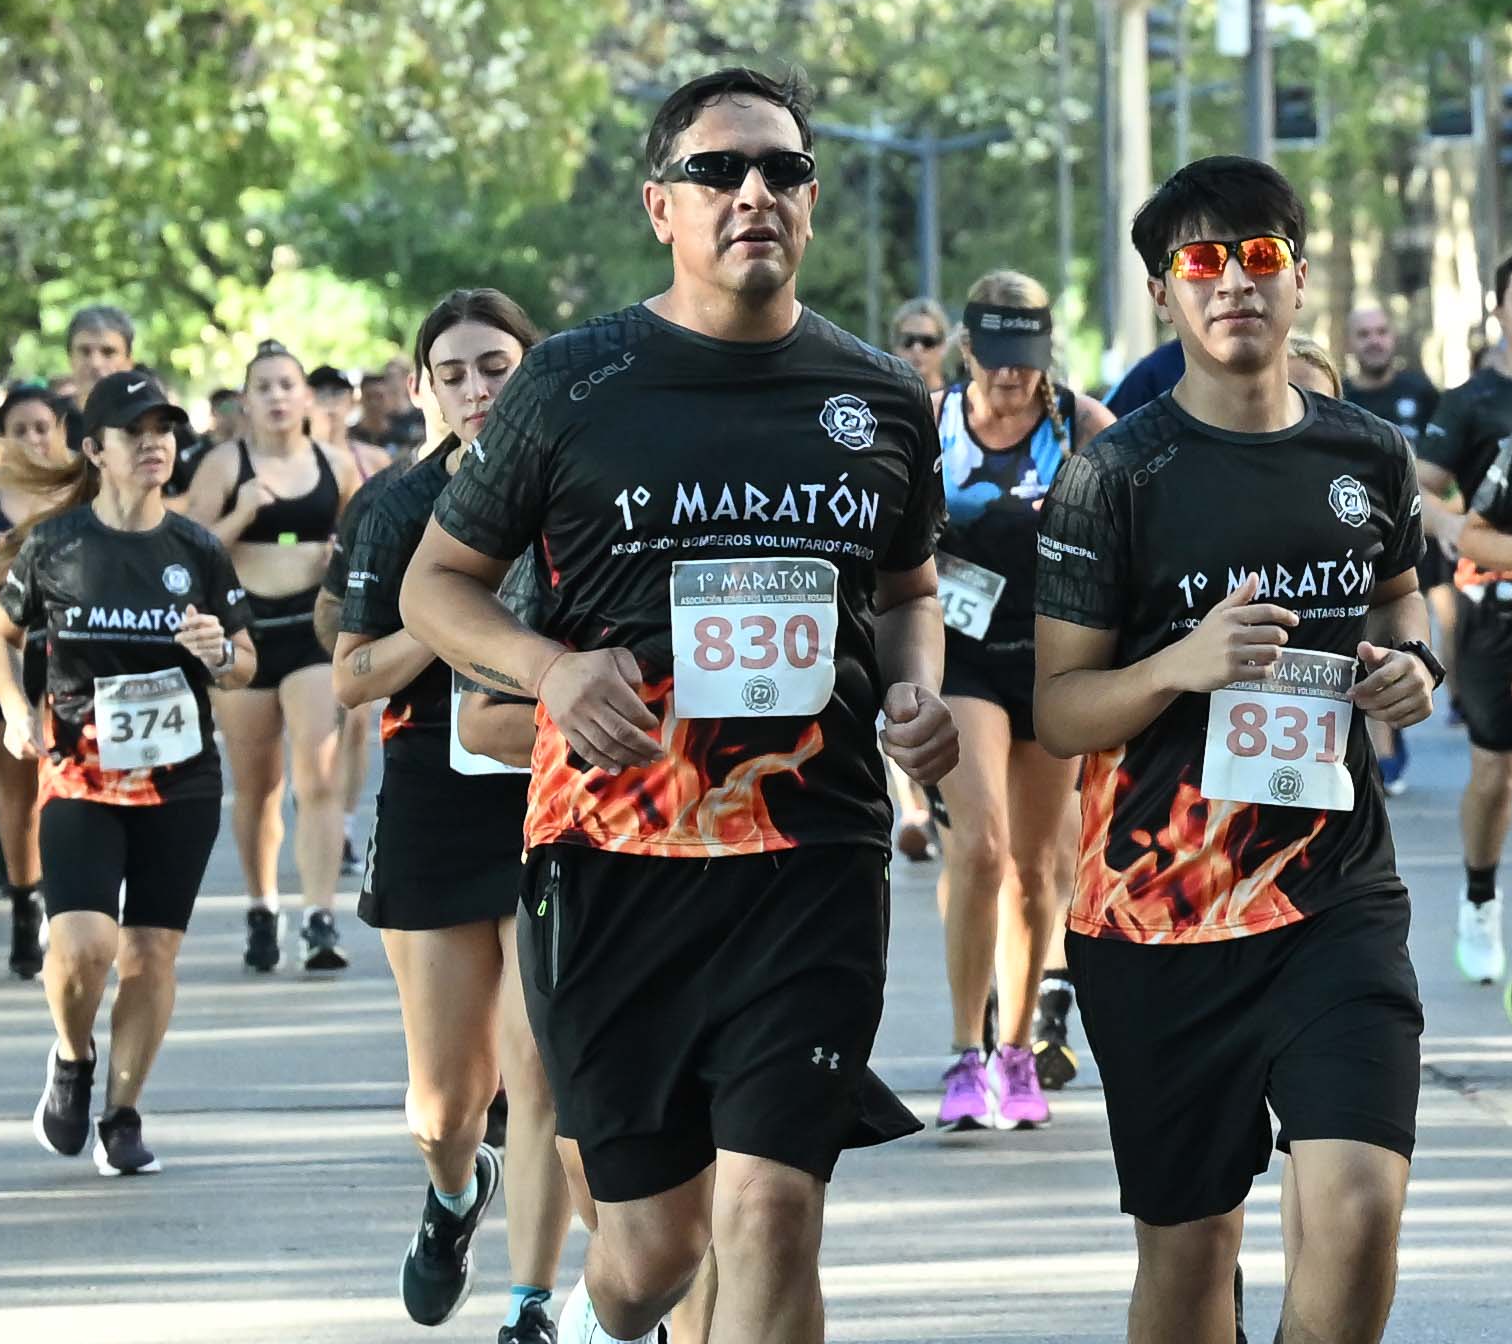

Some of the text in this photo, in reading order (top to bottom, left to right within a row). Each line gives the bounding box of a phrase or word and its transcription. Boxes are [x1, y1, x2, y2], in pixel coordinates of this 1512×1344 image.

[671, 472, 880, 532] MARATÓN
[682, 534, 752, 549] BOMBEROS
[754, 535, 842, 554] VOLUNTARIOS
[720, 565, 818, 592] MARATÓN
[693, 614, 820, 671] 830
[753, 687, 769, 702] 27
[110, 704, 186, 743] 374
[1226, 702, 1338, 763] 831
[1279, 777, 1295, 793] 27
